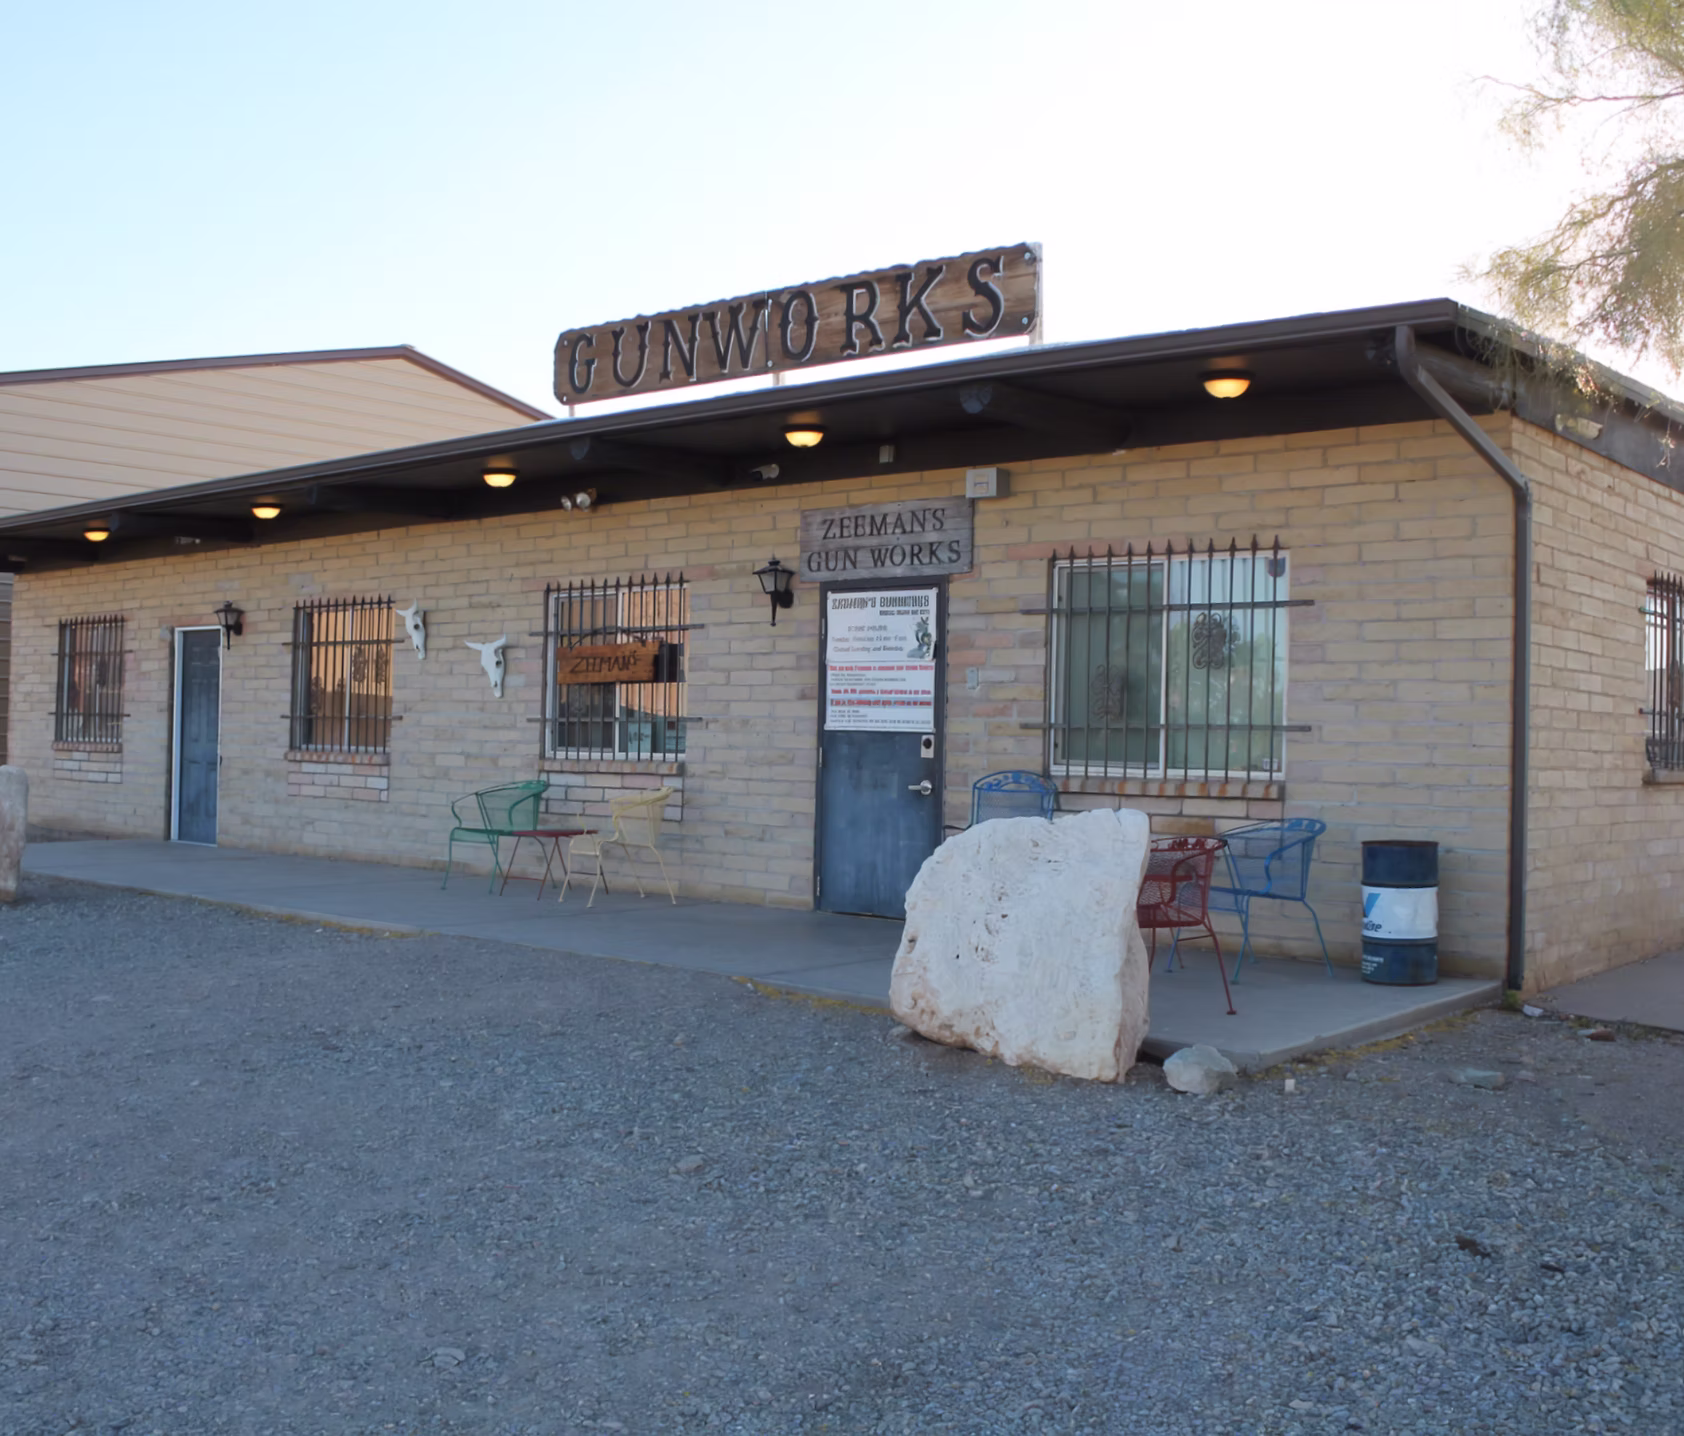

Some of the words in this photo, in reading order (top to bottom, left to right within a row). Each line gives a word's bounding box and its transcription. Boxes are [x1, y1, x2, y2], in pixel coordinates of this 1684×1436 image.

[568, 256, 1004, 395] GUNWORKS
[807, 550, 858, 573] GUN
[870, 540, 961, 568] WORKS
